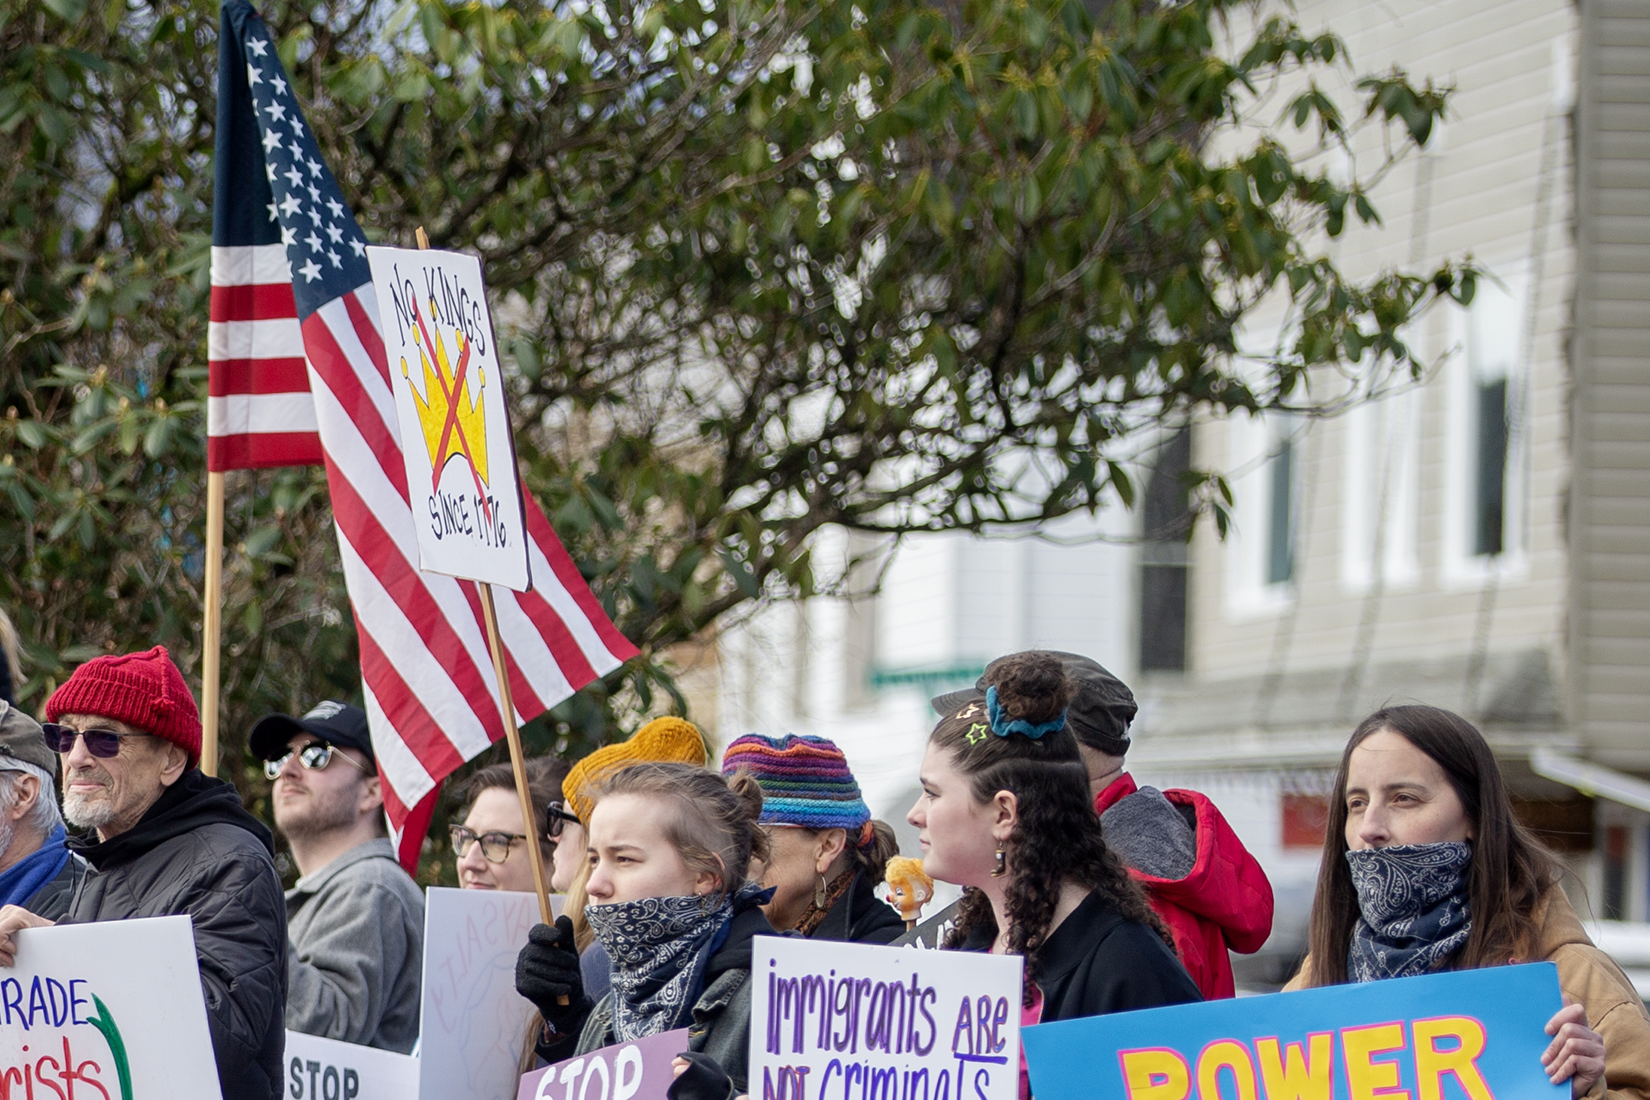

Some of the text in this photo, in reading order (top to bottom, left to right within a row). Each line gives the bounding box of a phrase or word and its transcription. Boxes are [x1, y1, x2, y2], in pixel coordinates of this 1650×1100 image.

[389, 264, 485, 357] NO KINGS
[428, 490, 506, 548] SINCE 1776
[766, 959, 937, 1056] immigrants
